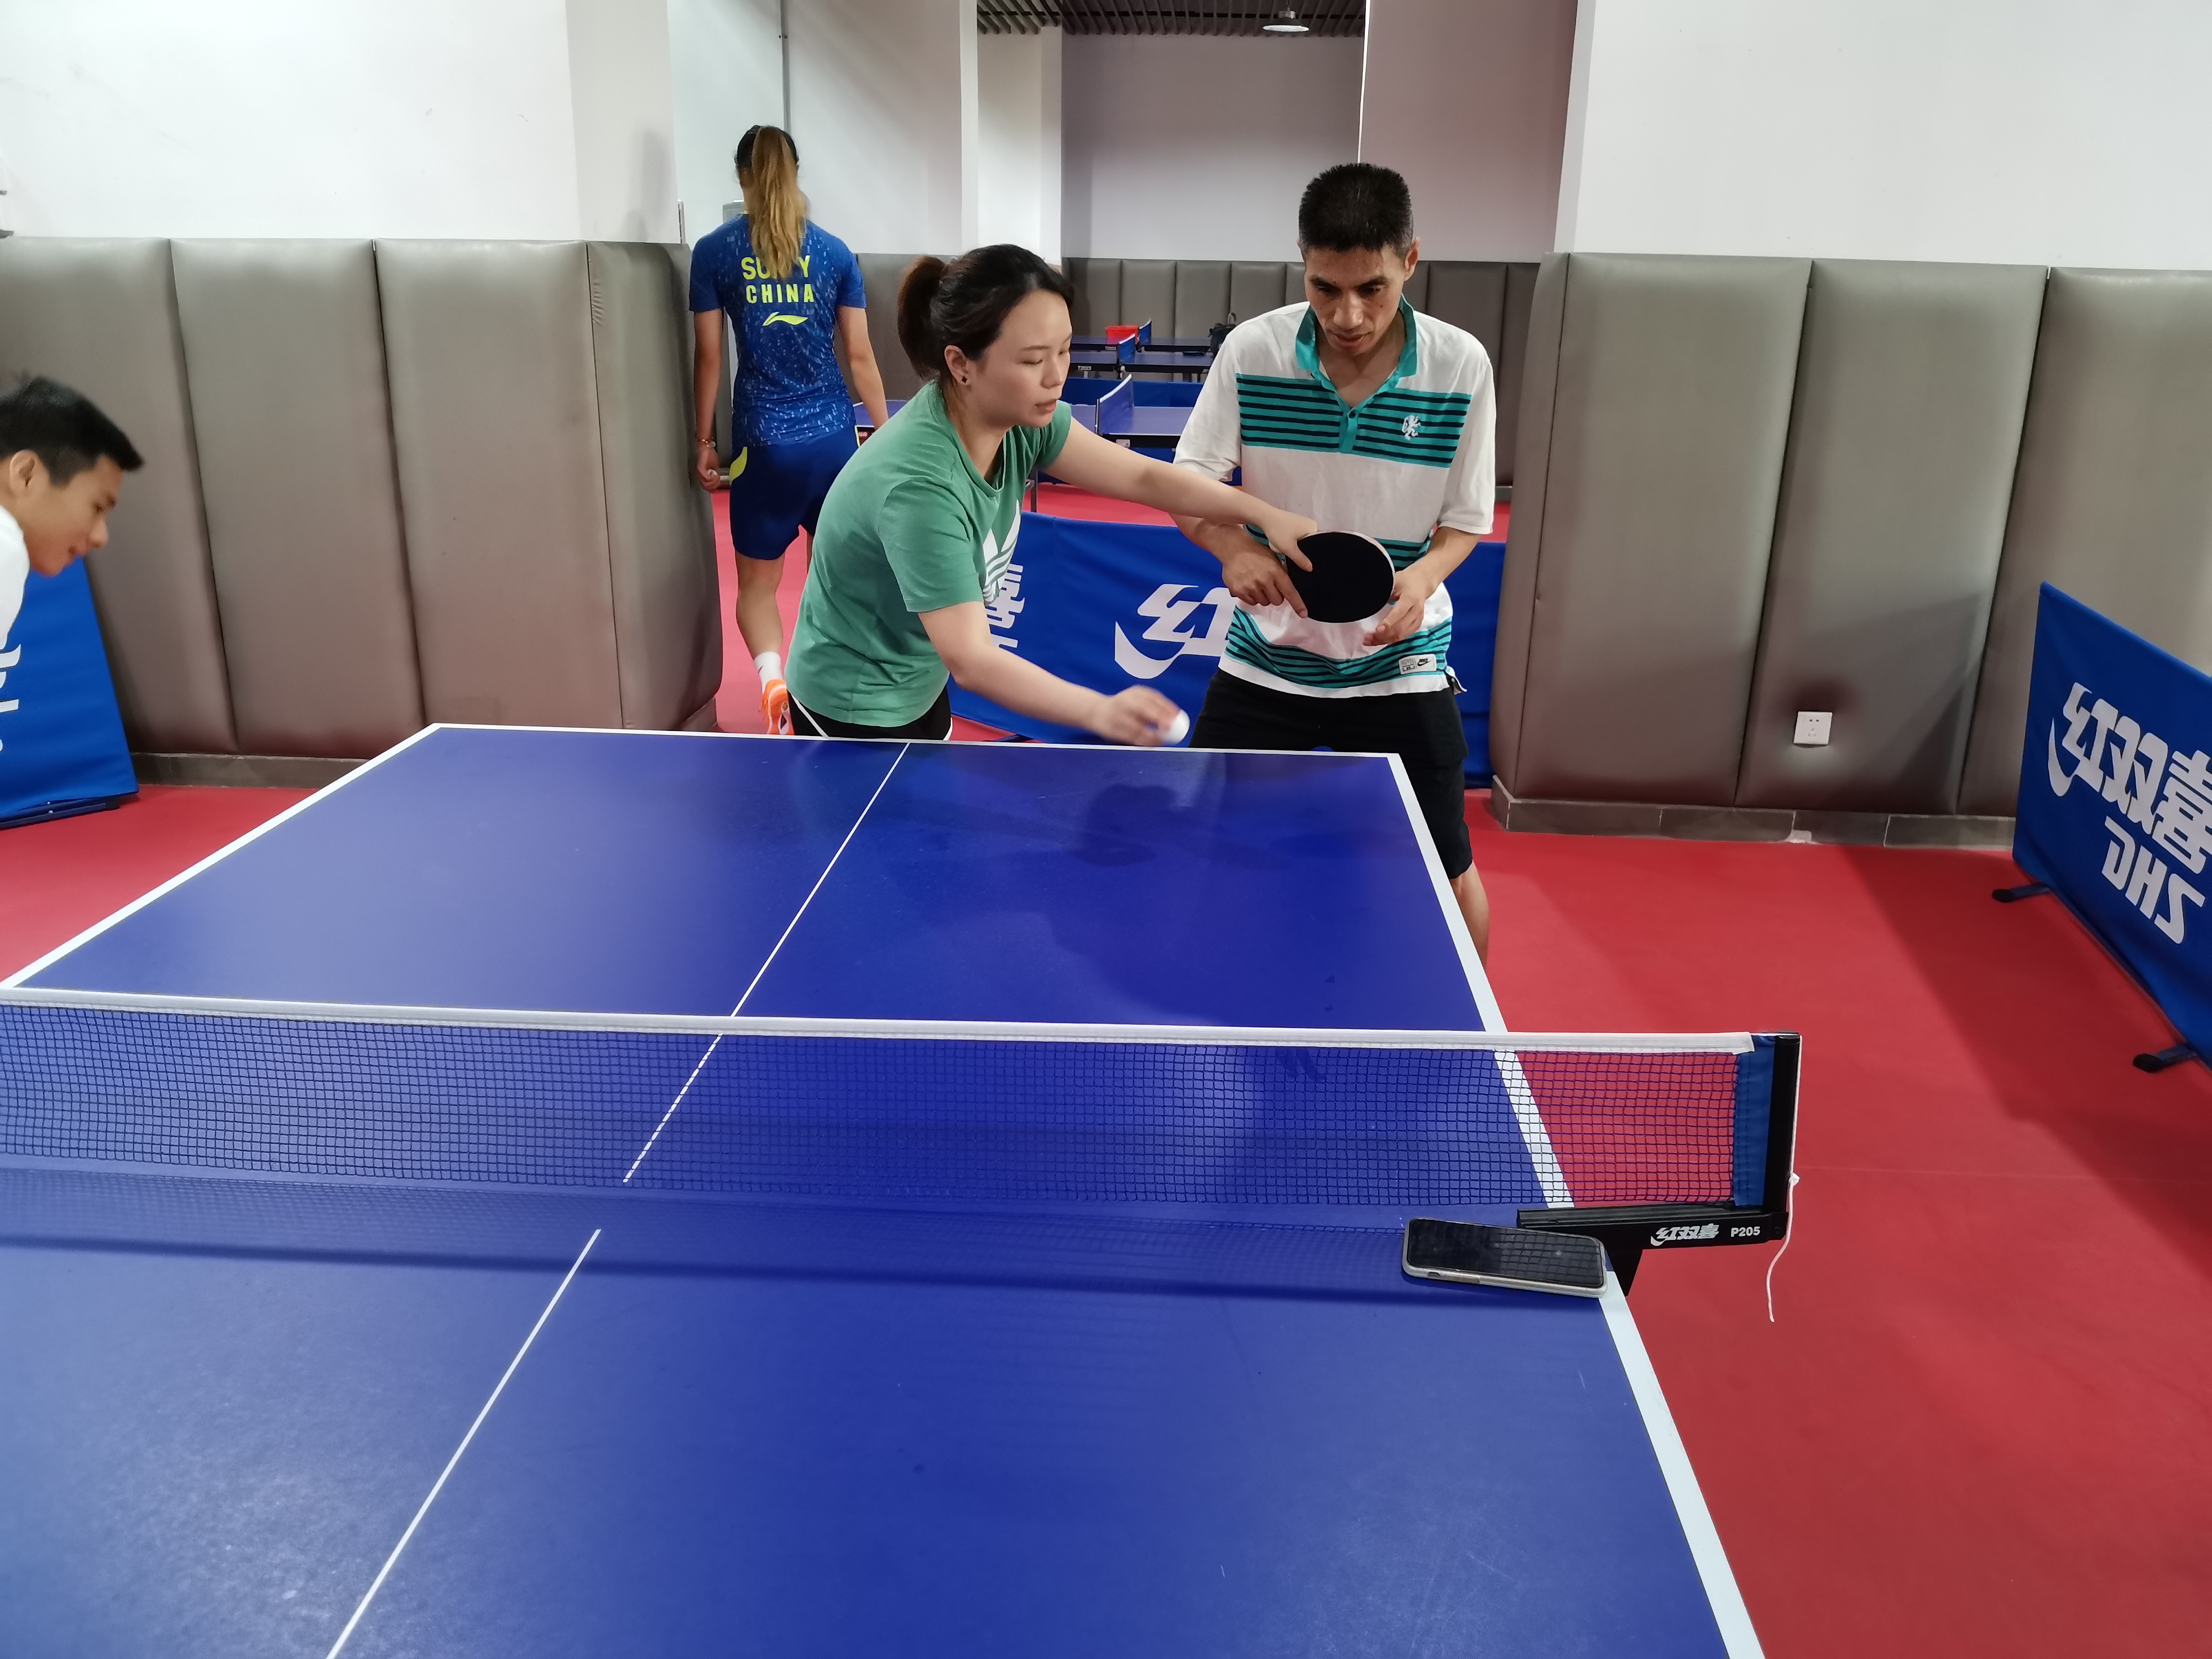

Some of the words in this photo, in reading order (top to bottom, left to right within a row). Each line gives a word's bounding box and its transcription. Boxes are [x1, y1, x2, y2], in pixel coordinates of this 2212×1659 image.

[742, 255, 811, 280] SUY
[746, 284, 815, 304] CHINA
[2102, 815, 2205, 944] DHS
[1651, 1223, 1719, 1246] 红双喜
[1731, 1227, 1760, 1238] P205
